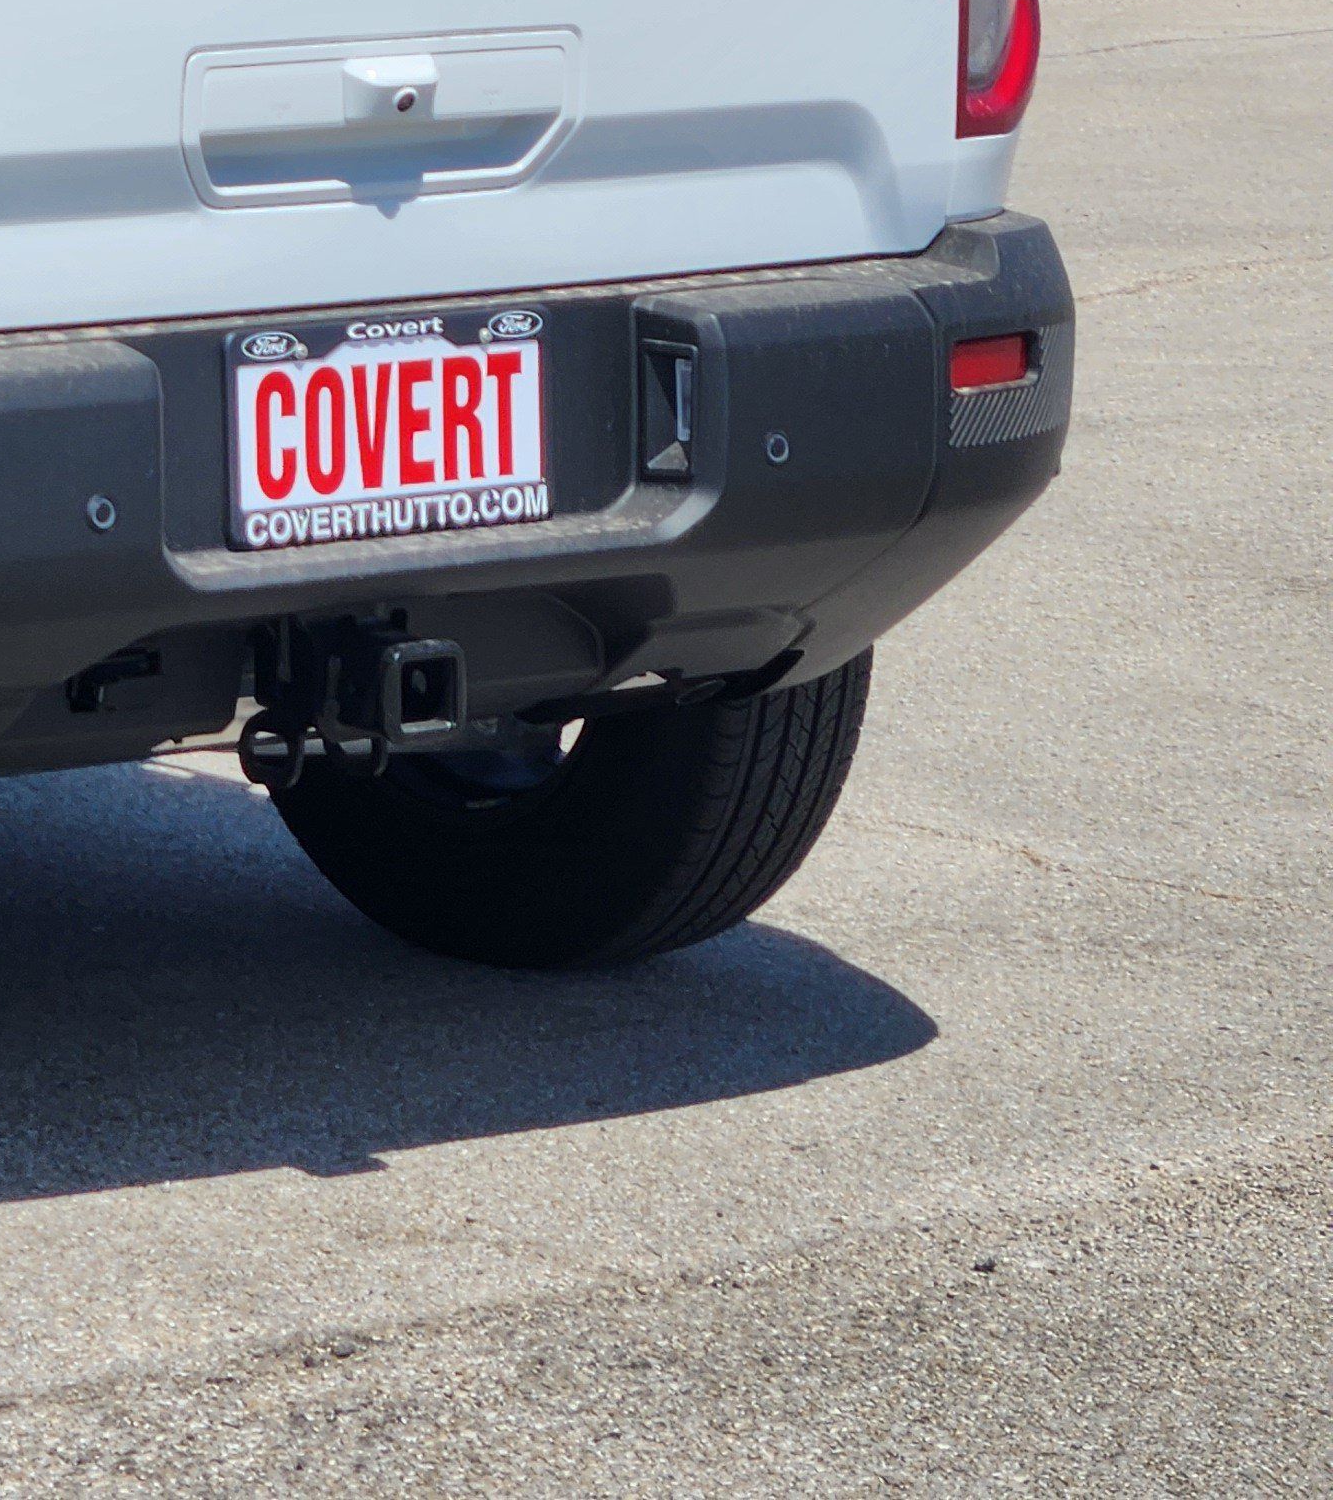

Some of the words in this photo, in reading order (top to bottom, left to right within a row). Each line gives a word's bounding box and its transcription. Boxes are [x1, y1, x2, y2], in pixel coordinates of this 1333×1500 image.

[346, 316, 444, 341] Covert
[256, 350, 523, 500] COVERT
[245, 483, 550, 546] COVERTHUTTO.COM
